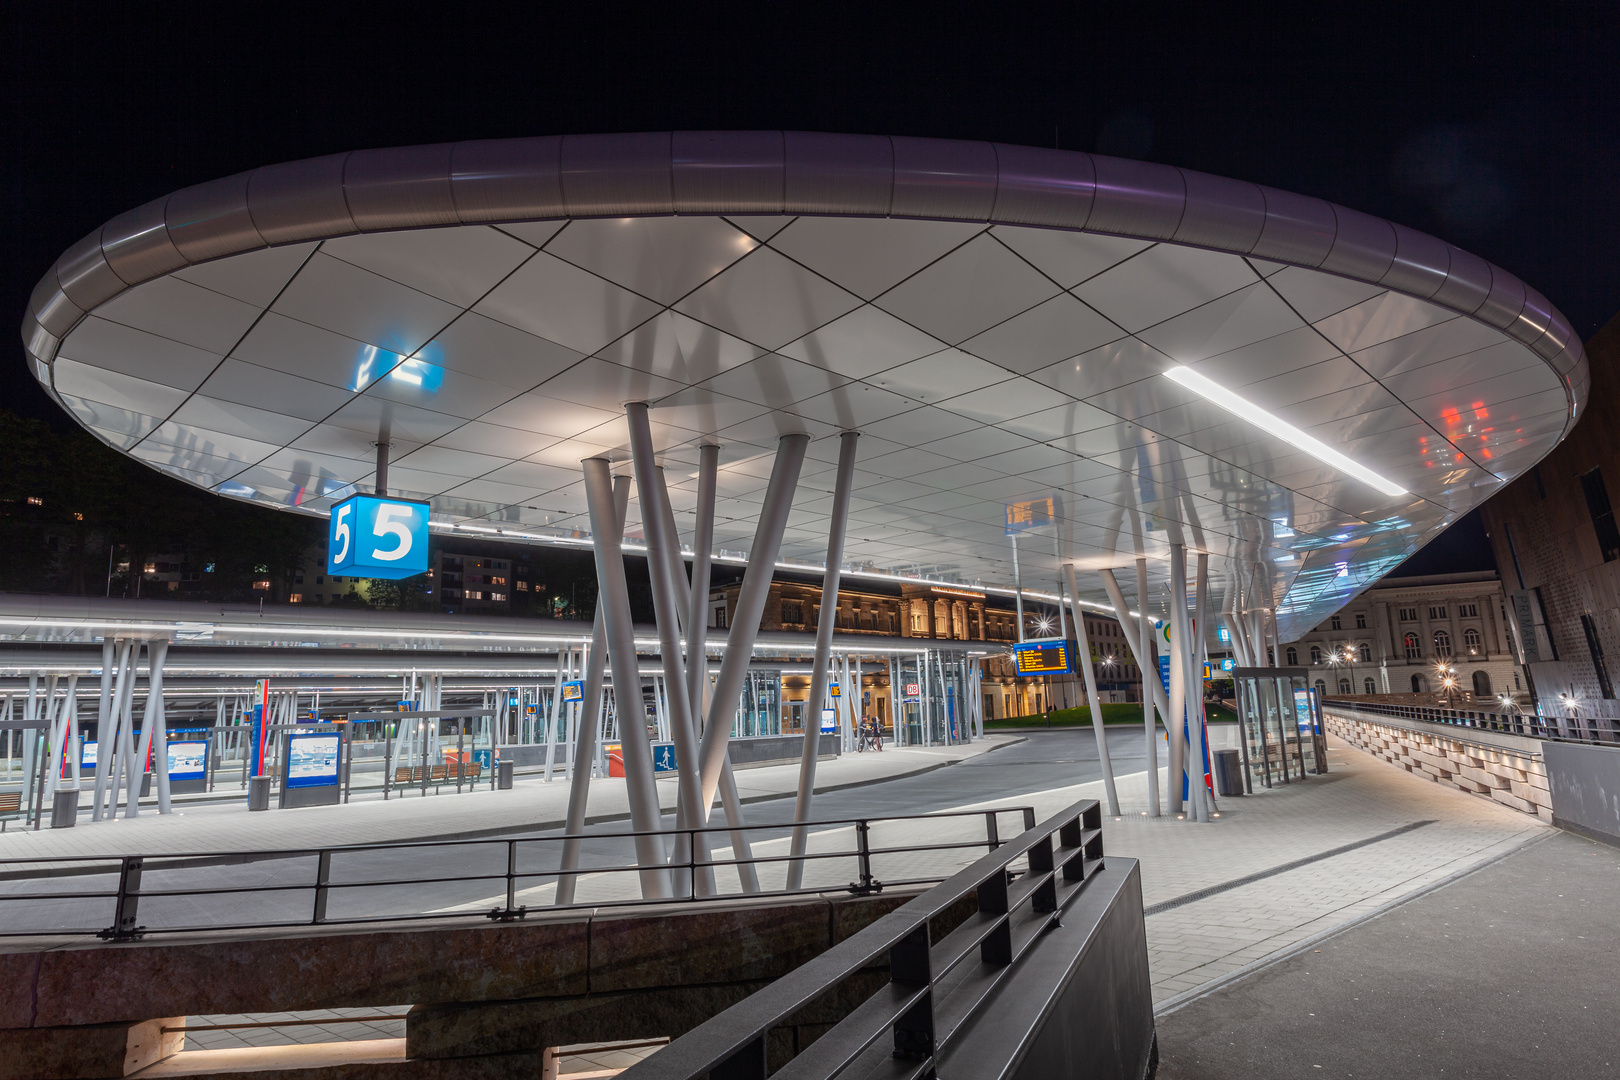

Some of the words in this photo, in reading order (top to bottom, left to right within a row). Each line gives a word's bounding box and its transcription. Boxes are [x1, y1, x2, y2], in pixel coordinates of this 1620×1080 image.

[334, 504, 351, 564] 5
[372, 503, 413, 561] 5
[1516, 595, 1538, 656] PRIMARK
[908, 685, 918, 693] DB
[1223, 660, 1233, 670] 5
